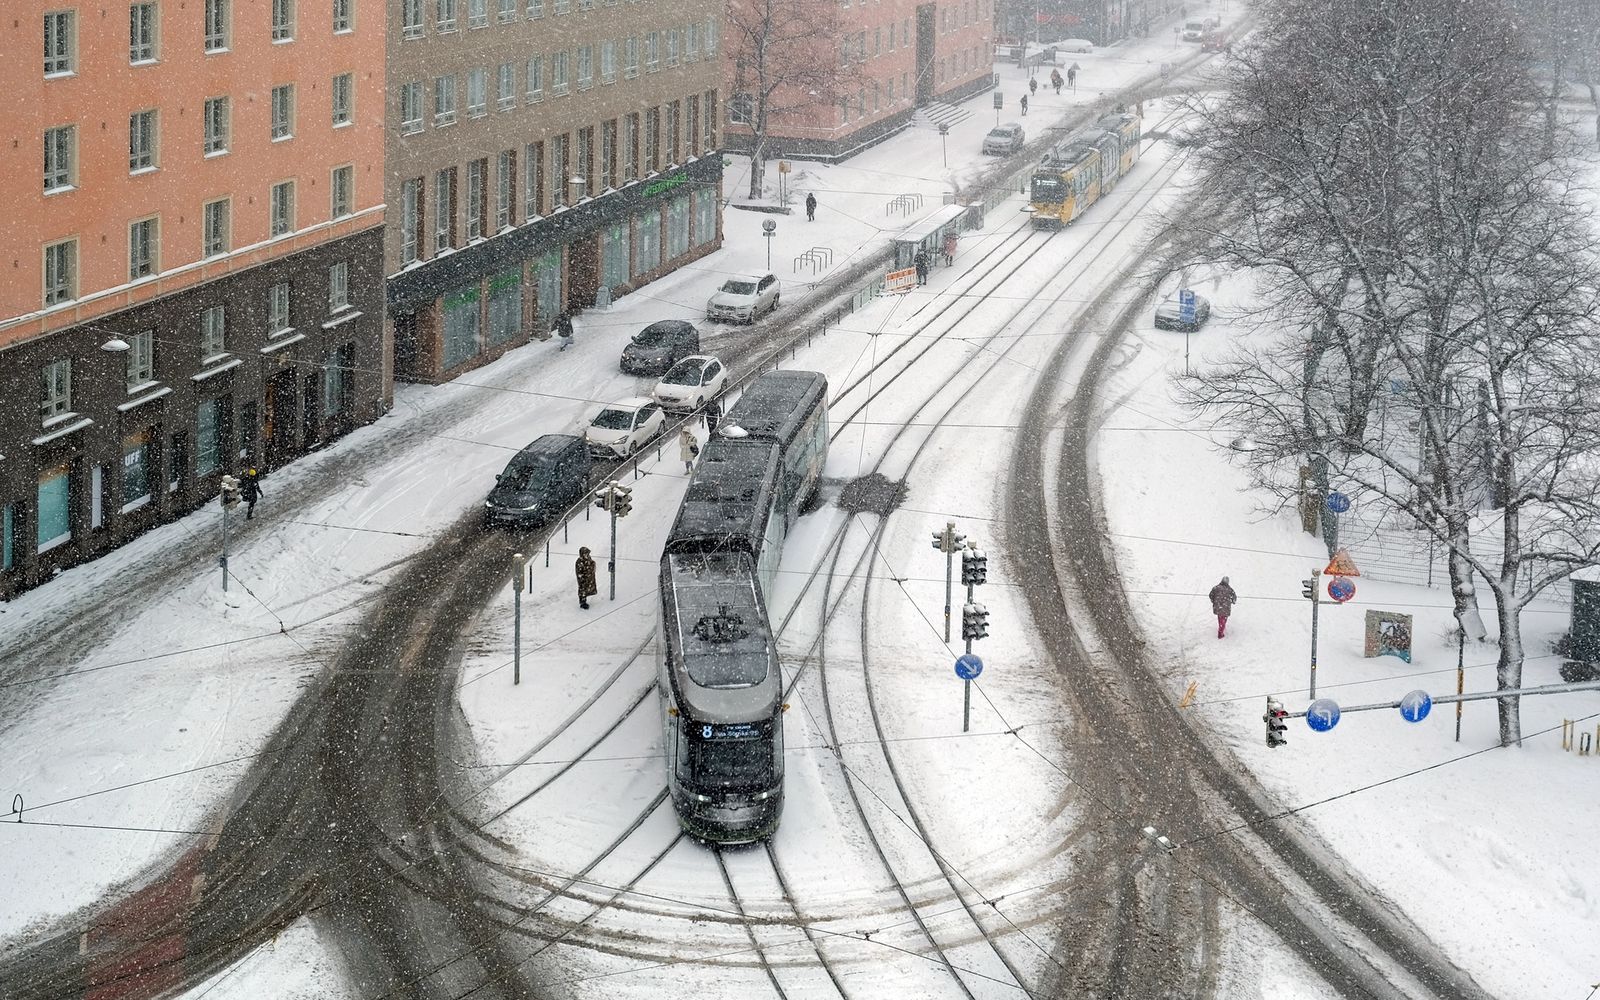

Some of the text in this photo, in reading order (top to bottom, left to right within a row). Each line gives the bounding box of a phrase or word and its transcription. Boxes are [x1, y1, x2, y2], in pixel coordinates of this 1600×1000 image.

[1183, 291, 1193, 304] P
[125, 450, 141, 466] UFF
[702, 725, 713, 738] 8
